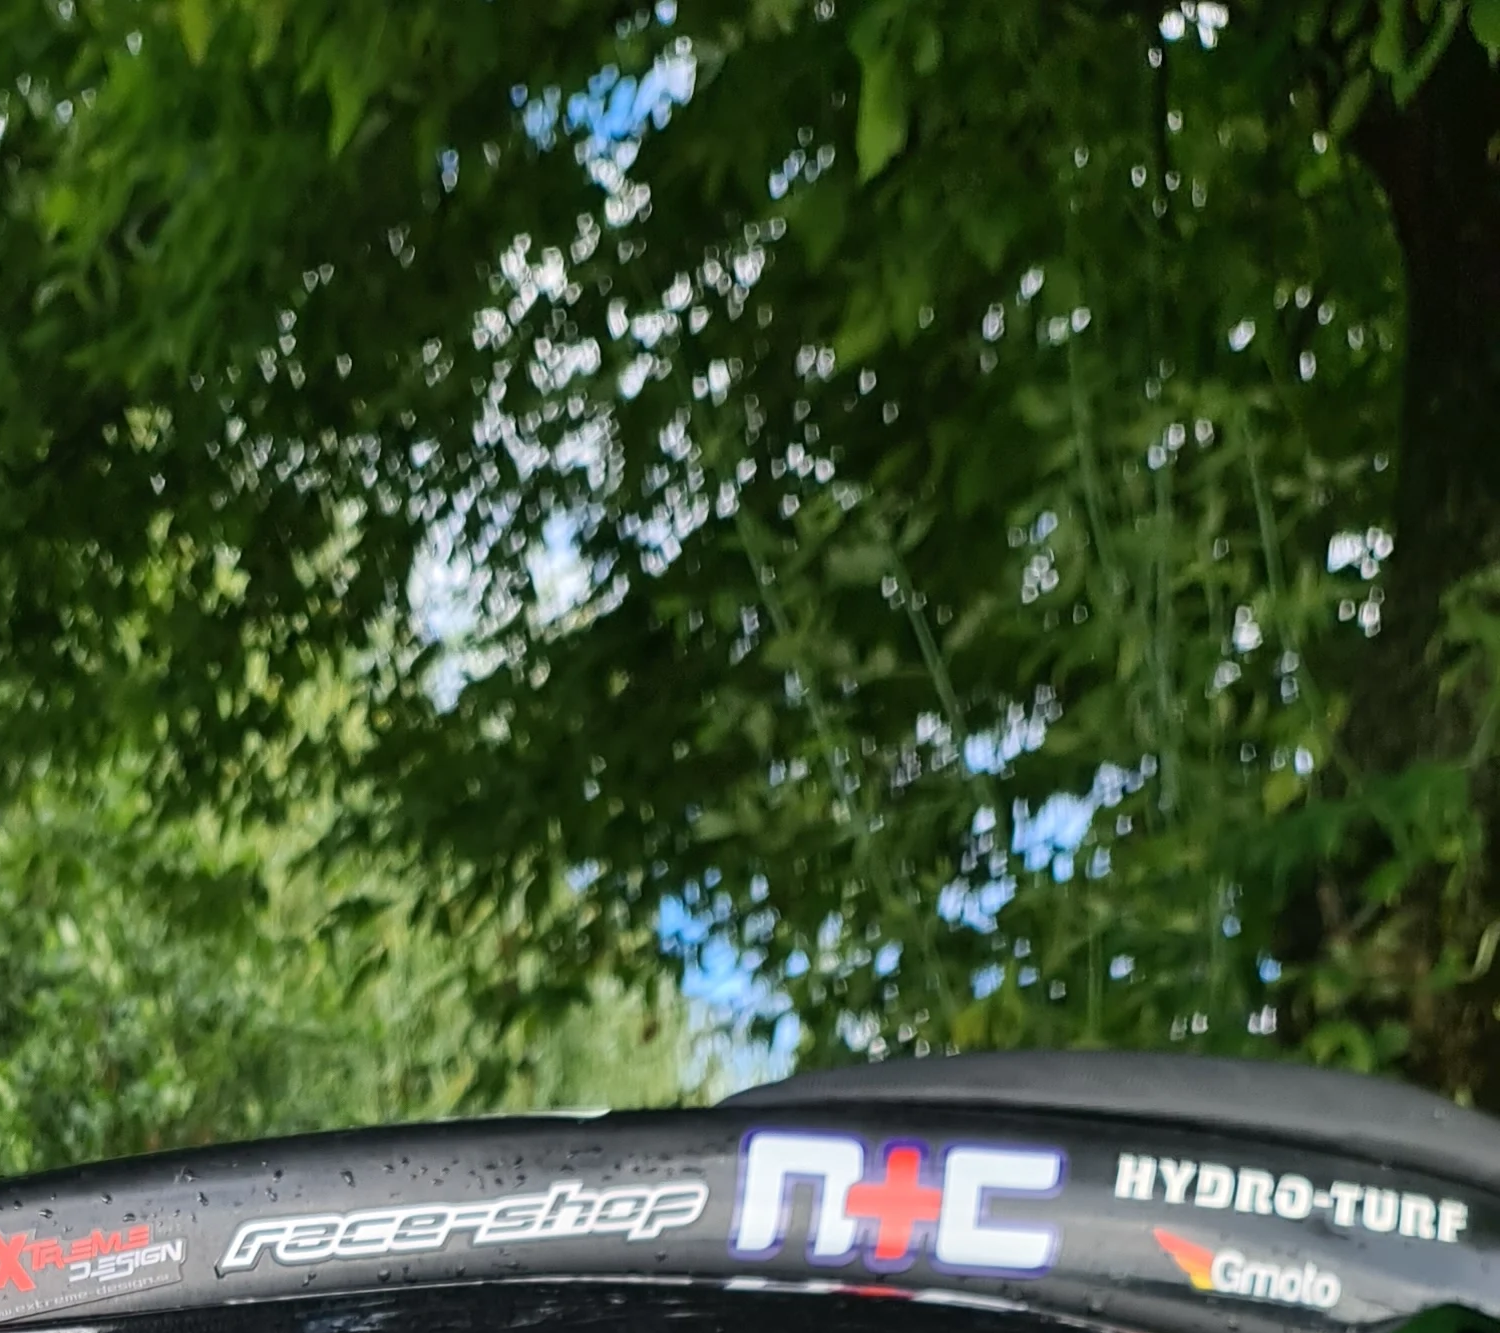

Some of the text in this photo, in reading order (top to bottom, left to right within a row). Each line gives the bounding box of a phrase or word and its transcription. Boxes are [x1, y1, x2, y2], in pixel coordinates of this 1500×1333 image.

[222, 1181, 708, 1271] race-shop
[1114, 1152, 1469, 1243] HYDRO-TURF
[68, 1238, 184, 1283] DESIGN
[1211, 1248, 1342, 1308] Gmoto
